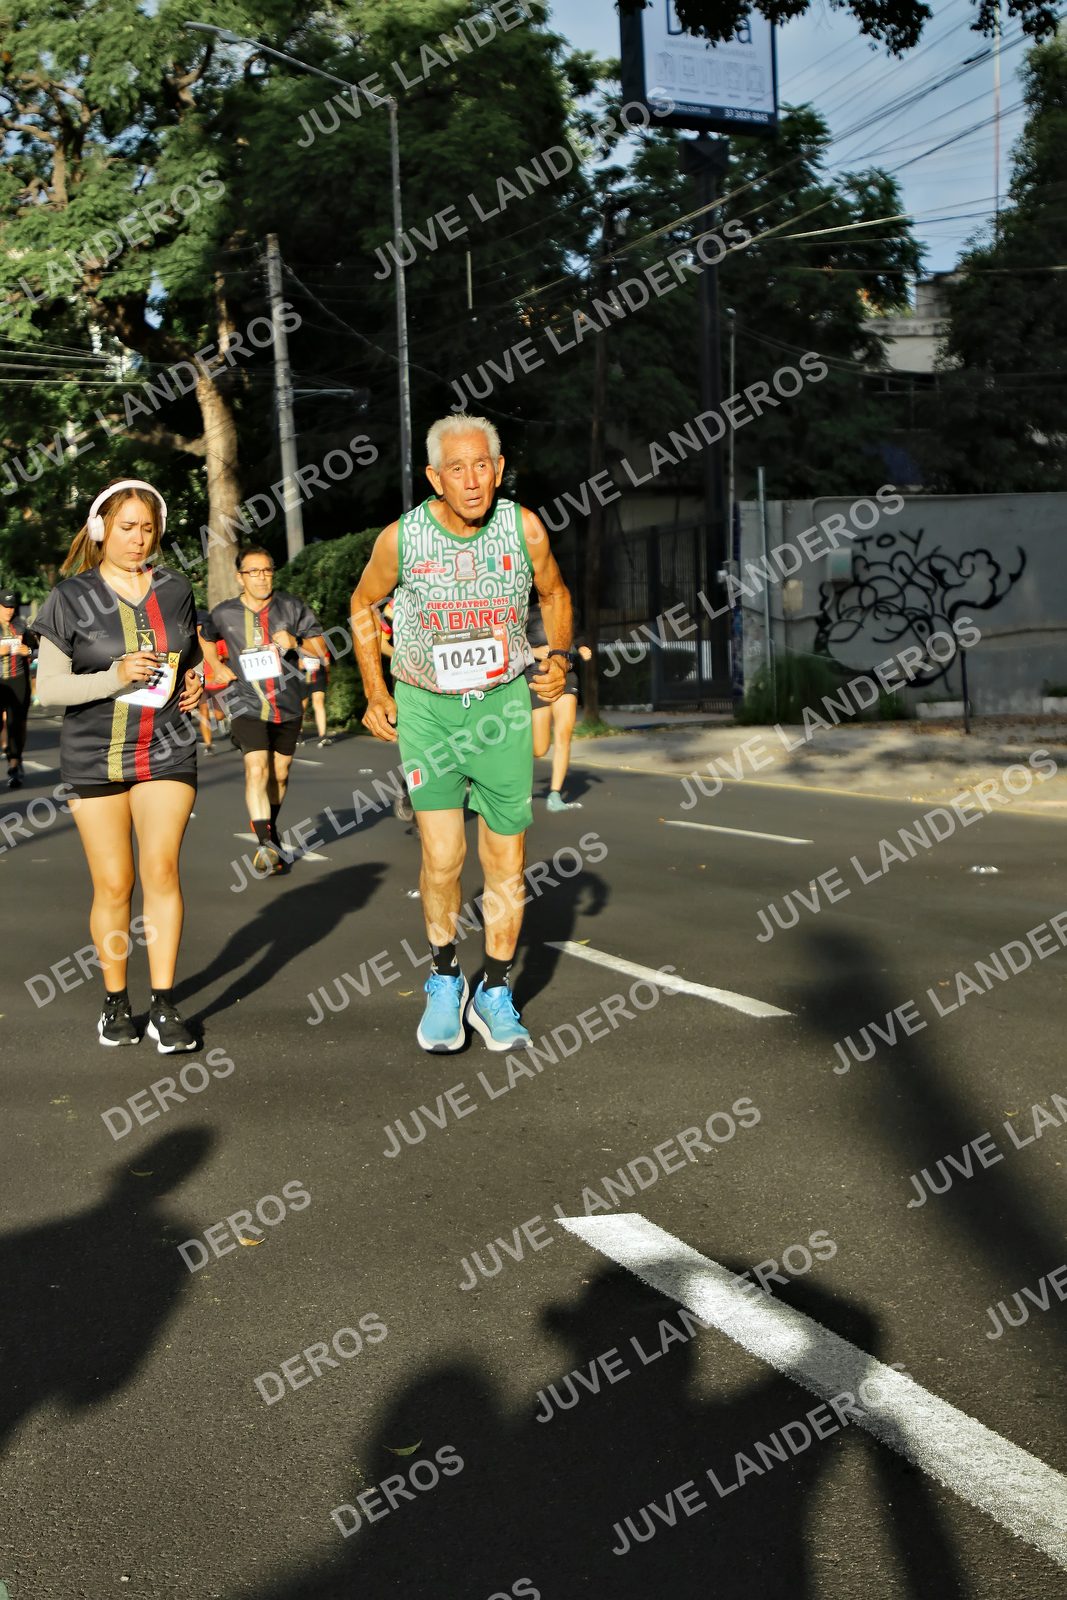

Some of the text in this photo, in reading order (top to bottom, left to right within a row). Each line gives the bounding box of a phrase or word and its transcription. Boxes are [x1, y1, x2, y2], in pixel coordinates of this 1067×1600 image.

[854, 529, 924, 556] TOY
[427, 601, 454, 609] FUEGO
[419, 606, 518, 631] LA BARCA
[438, 645, 497, 671] 10421
